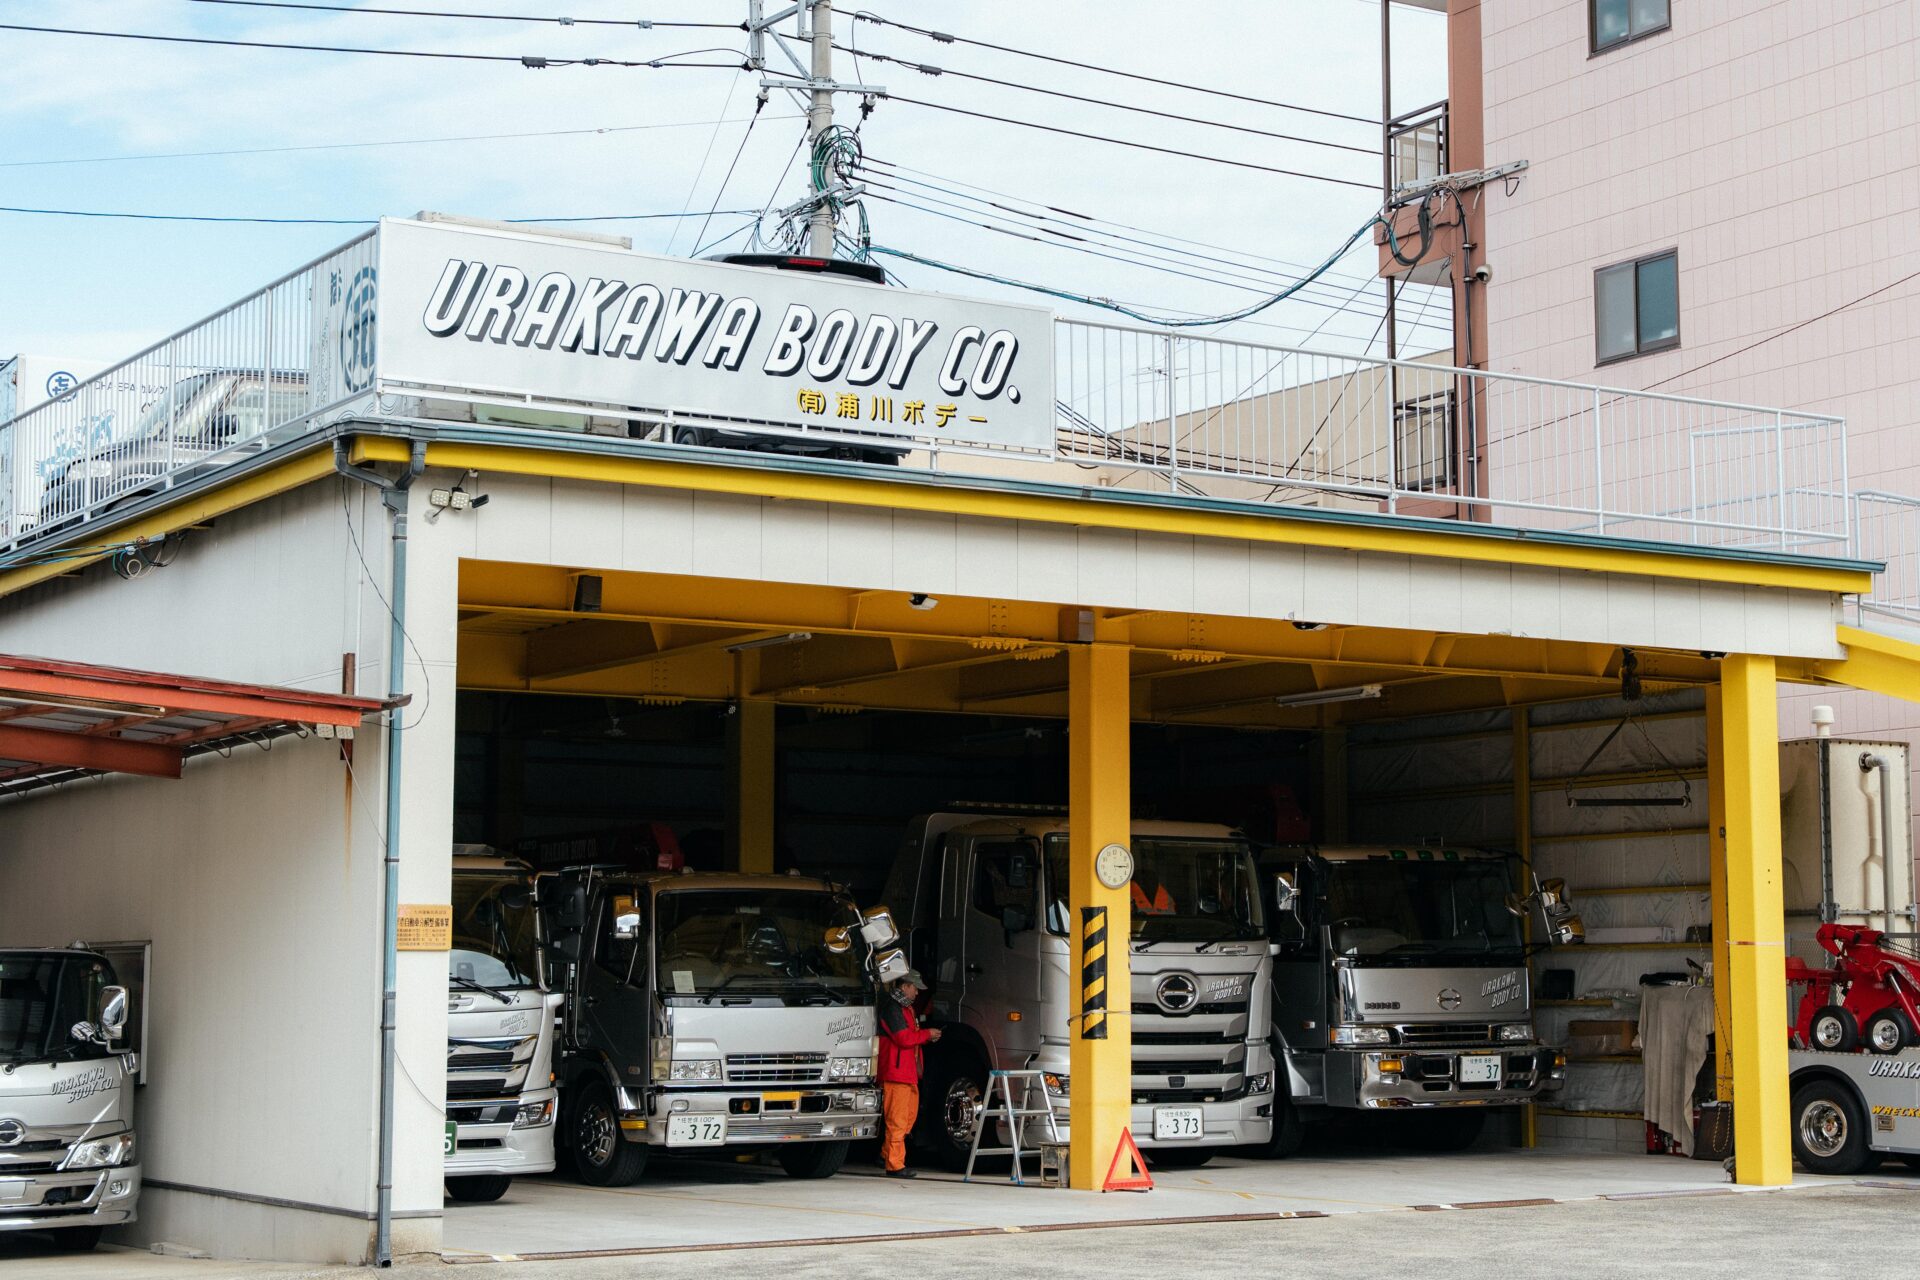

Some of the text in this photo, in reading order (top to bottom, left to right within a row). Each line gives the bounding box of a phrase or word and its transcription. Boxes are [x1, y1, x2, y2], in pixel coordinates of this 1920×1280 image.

[423, 259, 760, 371] URAKAWA
[764, 304, 938, 390] BODY
[939, 326, 1021, 404] CO.
[1206, 976, 1240, 993] URAKAWA
[1214, 987, 1233, 1001] BODY
[1481, 971, 1516, 998] URAKAWA
[1491, 988, 1511, 1008] BODY
[51, 1066, 105, 1096] URAKAWA
[67, 1081, 98, 1104] BODY
